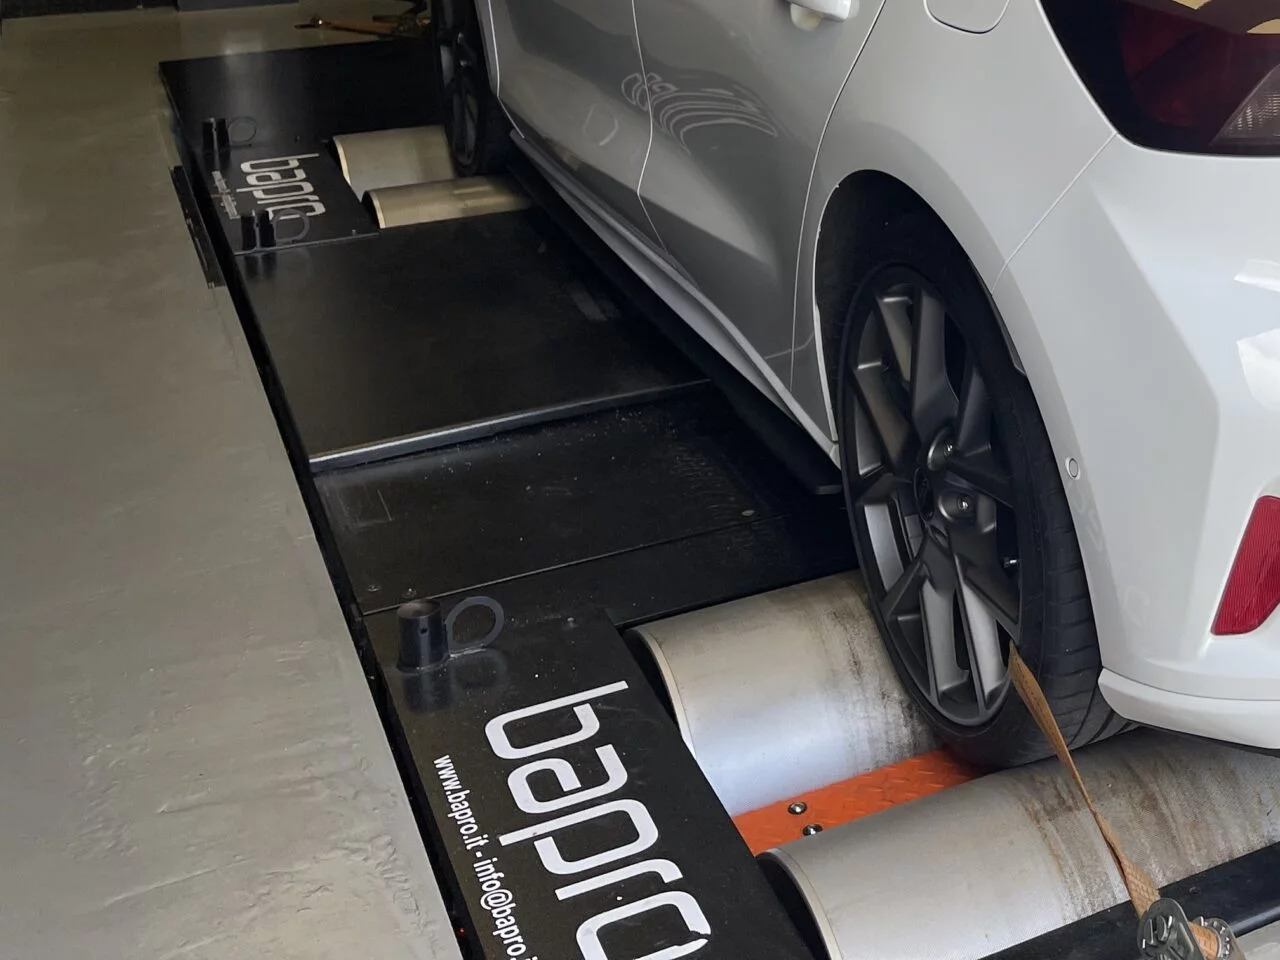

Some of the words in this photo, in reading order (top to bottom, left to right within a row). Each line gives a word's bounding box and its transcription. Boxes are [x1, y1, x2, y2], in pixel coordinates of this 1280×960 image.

[236, 153, 326, 220] bapro
[433, 754, 489, 850] www.bapro.it
[473, 857, 539, 960] info@bapro.
[484, 680, 711, 960] bapro
